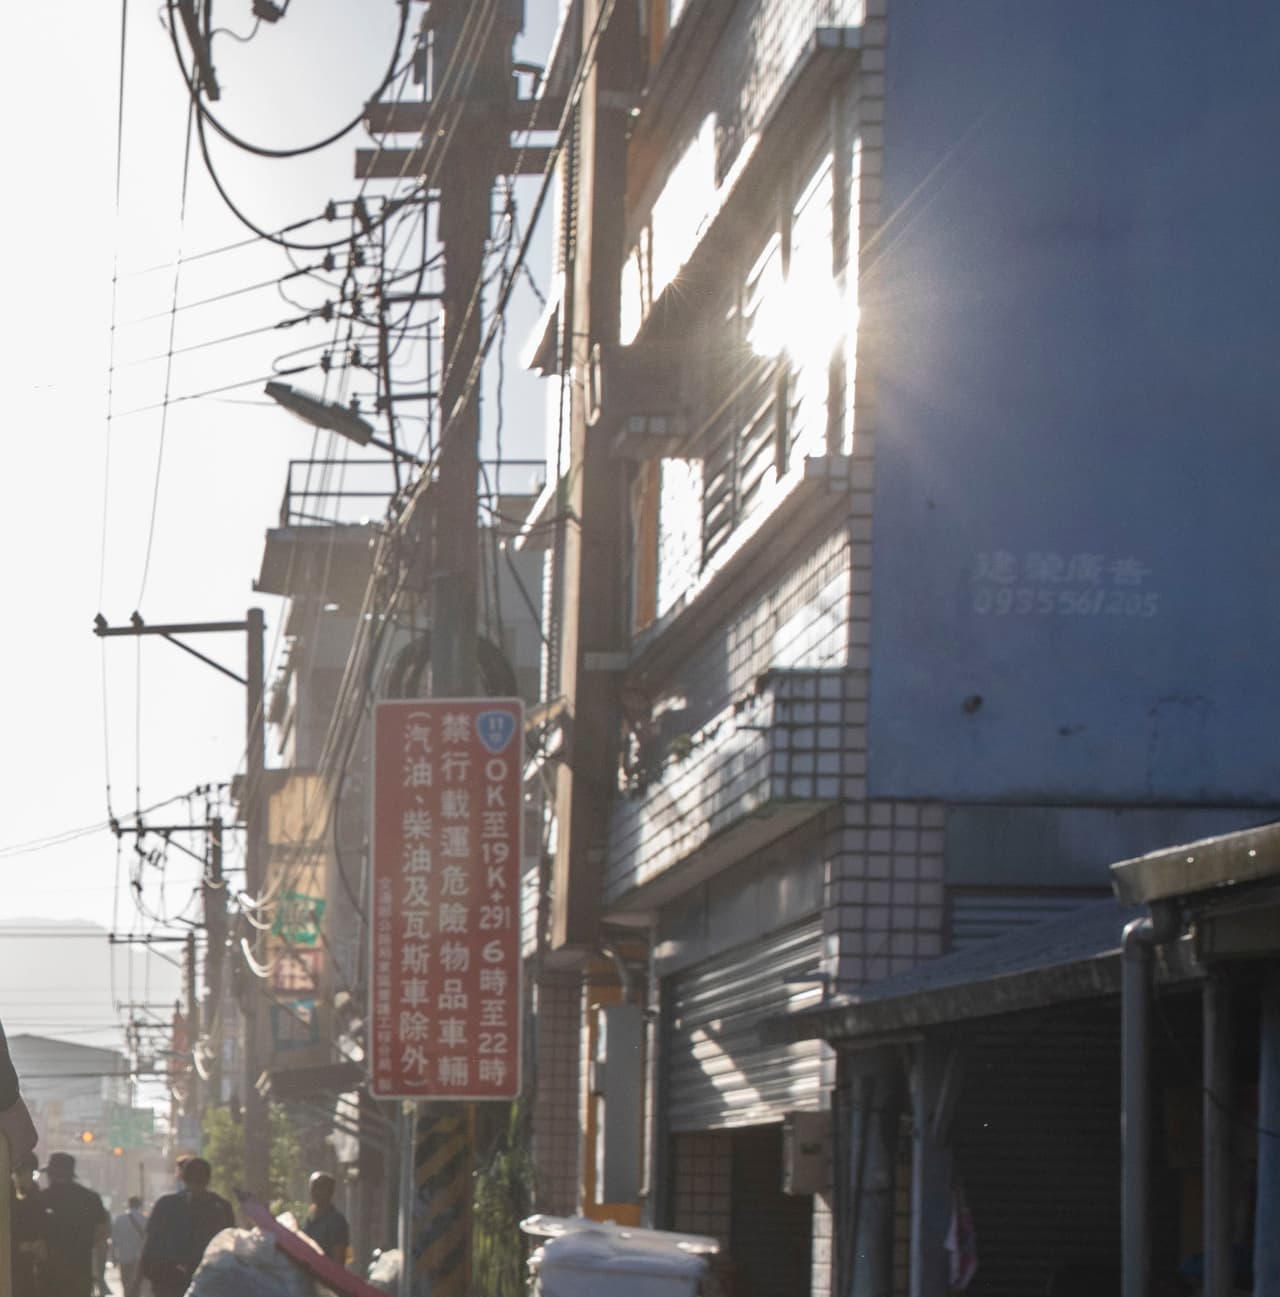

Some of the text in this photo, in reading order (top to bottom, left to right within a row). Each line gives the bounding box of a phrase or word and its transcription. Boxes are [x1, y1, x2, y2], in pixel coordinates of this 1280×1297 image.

[439, 713, 471, 1087] 禁行載運危險物品車輛
